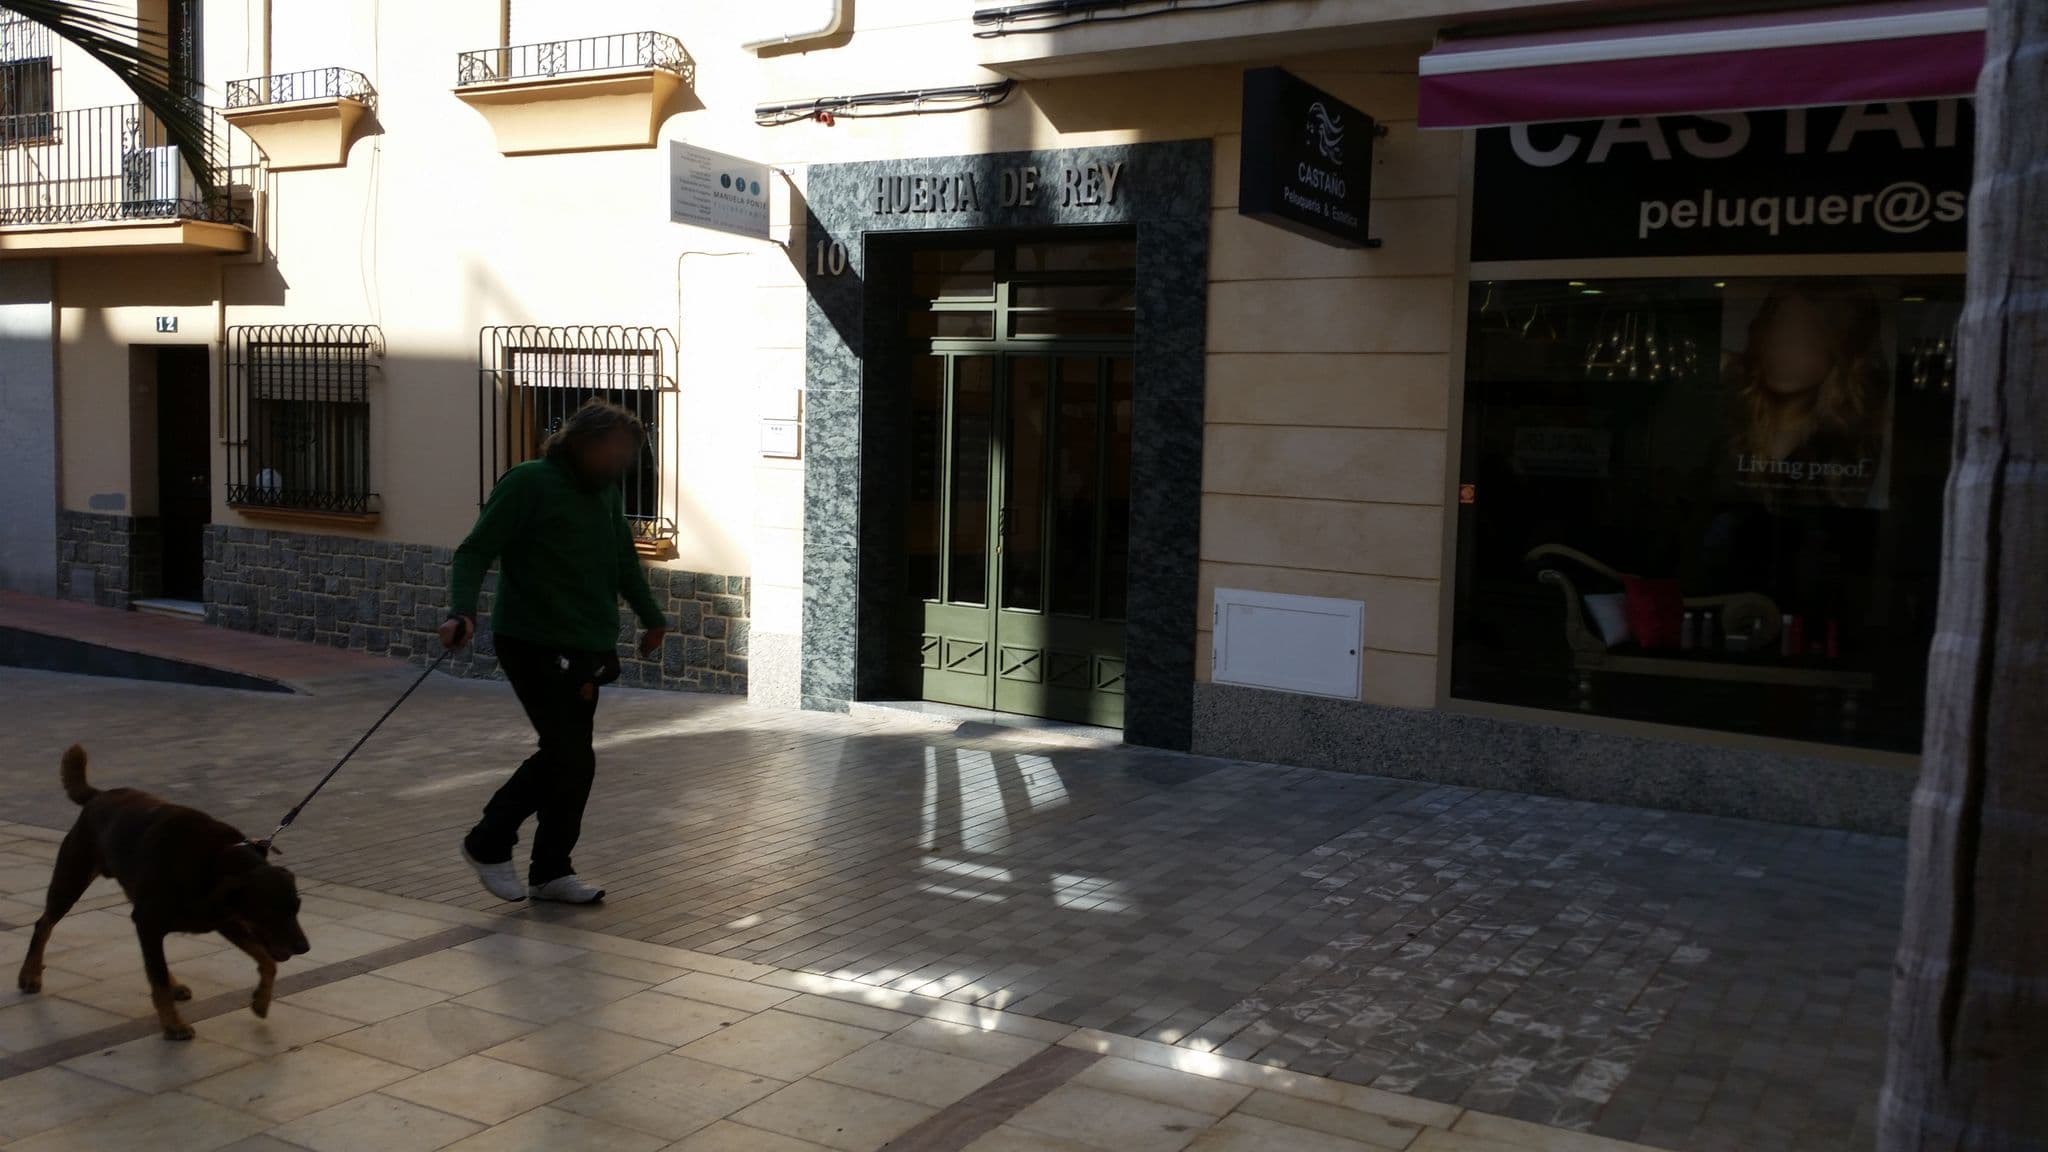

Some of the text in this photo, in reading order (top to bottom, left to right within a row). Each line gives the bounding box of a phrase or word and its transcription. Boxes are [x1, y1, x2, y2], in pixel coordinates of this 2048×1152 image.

[873, 161, 1124, 213] HUERTA DE REY
[1638, 181, 1966, 239] peluquer@s
[816, 239, 846, 276] 10
[158, 316, 175, 331] 12
[1736, 453, 1803, 480] Living
